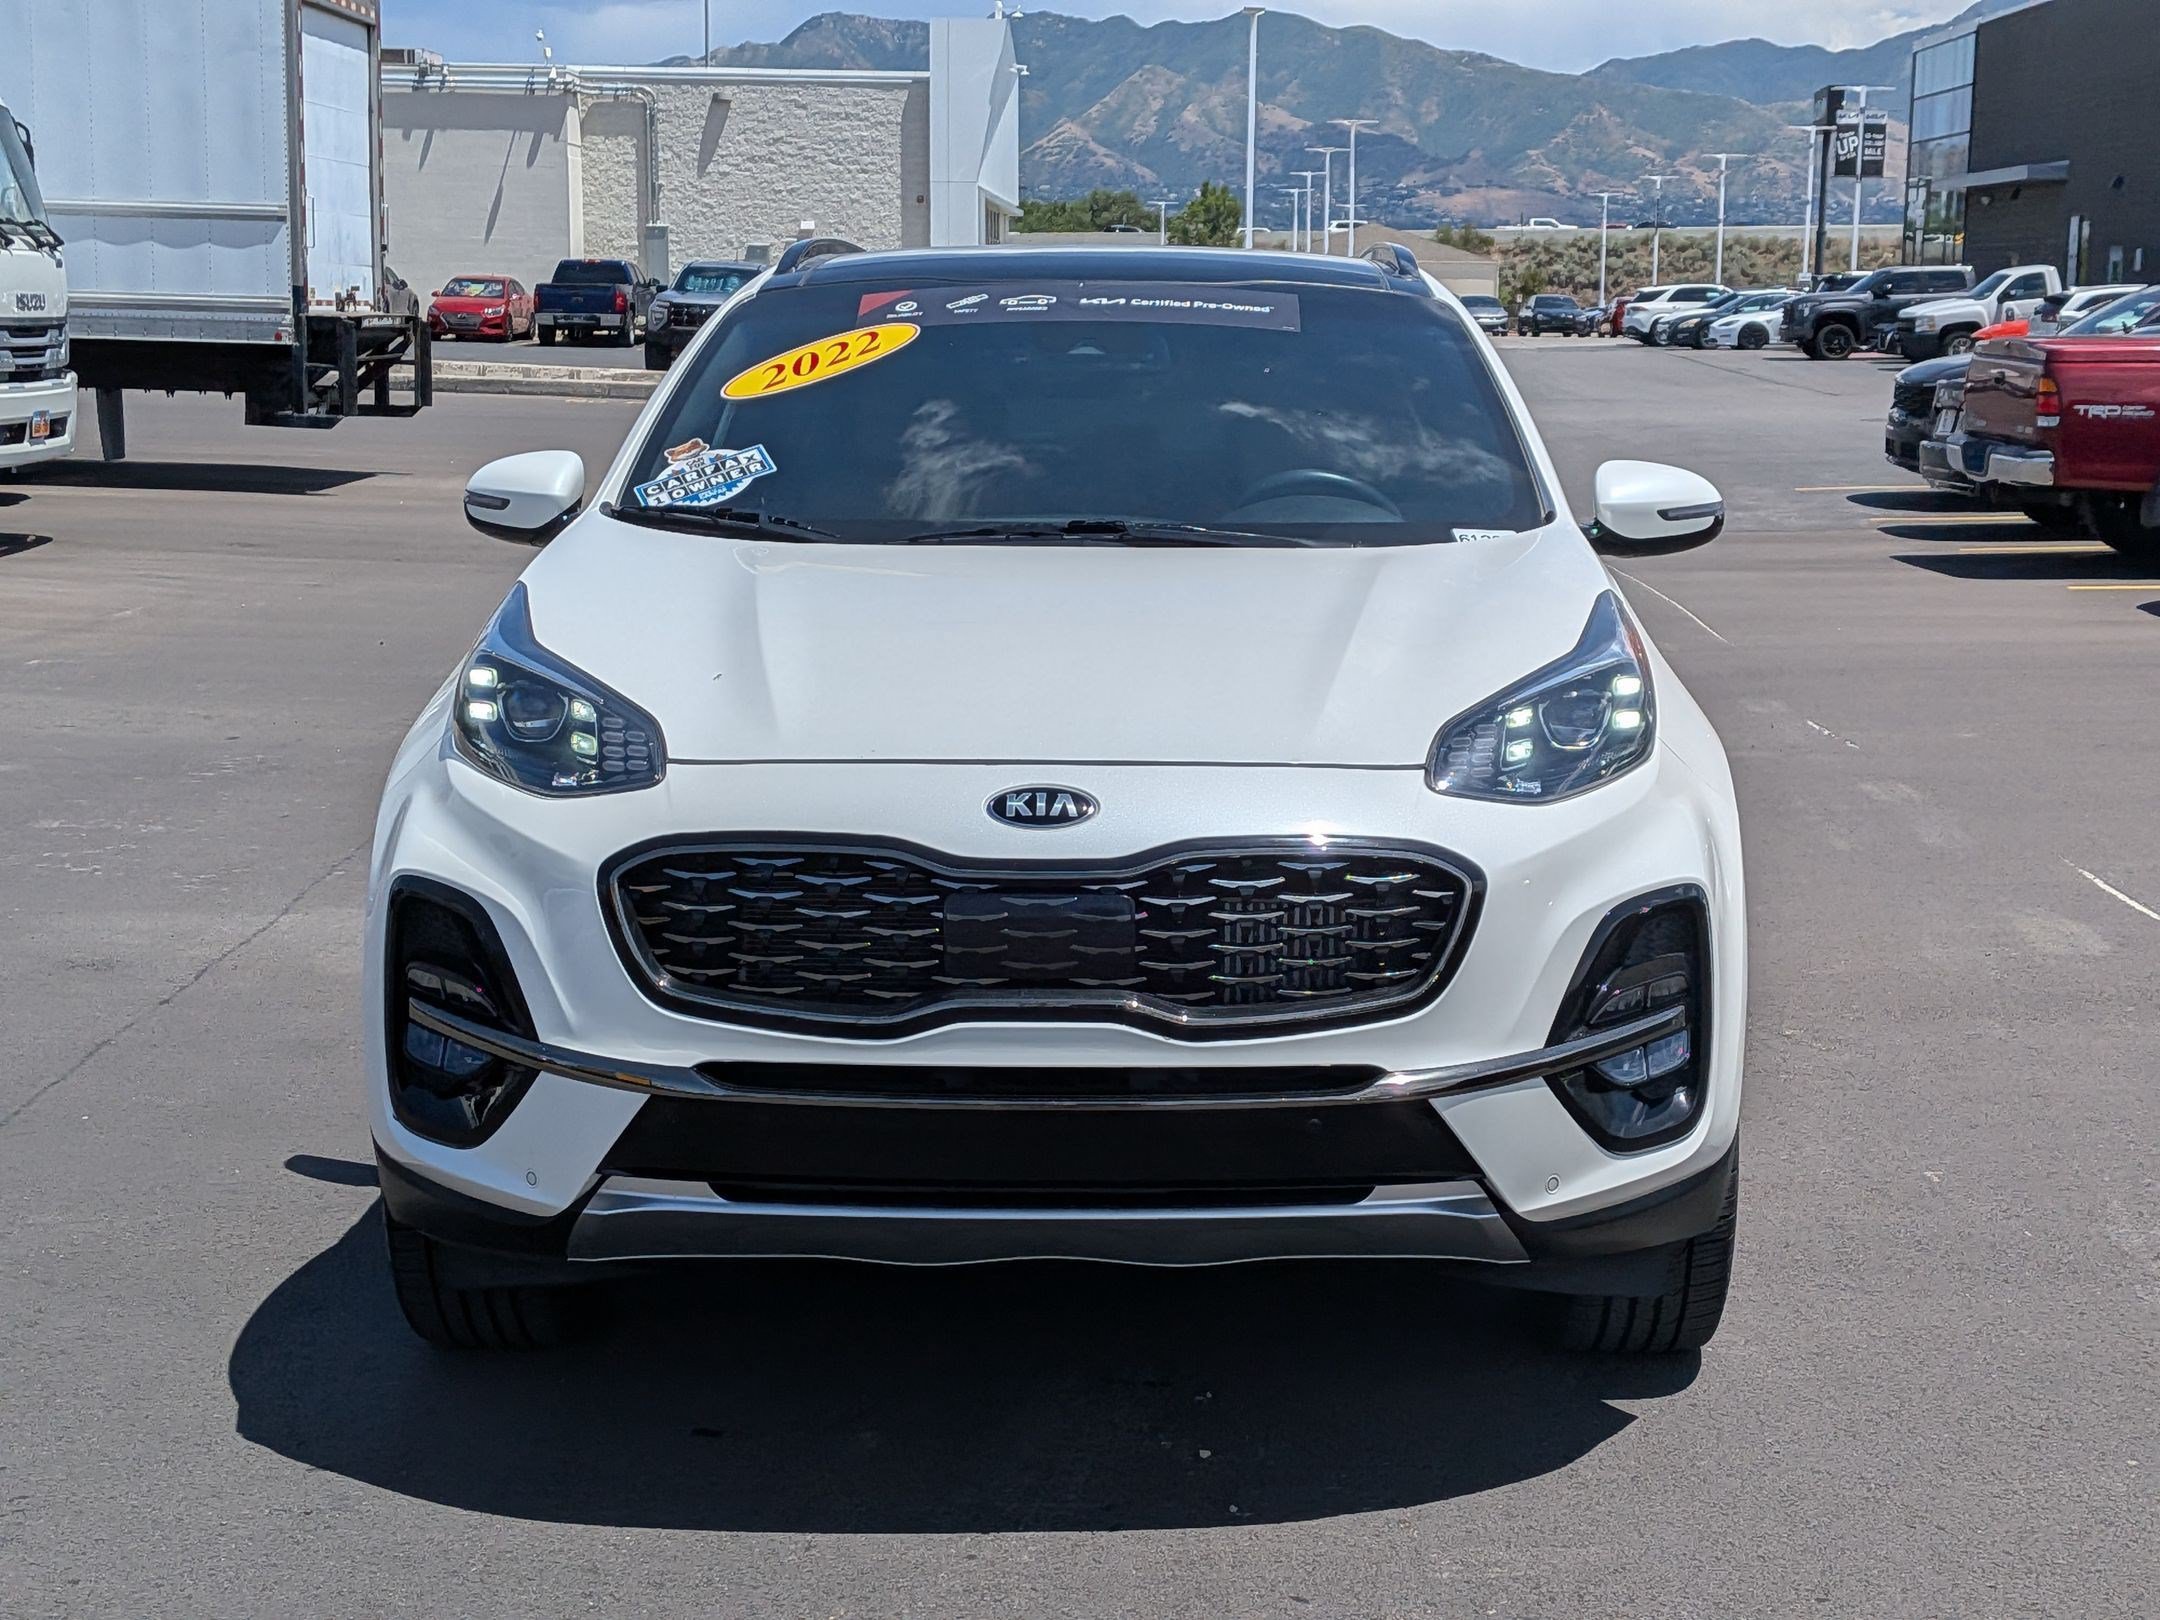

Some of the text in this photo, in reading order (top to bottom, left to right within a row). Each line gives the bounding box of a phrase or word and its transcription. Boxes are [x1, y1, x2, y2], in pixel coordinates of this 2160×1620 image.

[1836, 135, 1859, 155] UP
[16, 293, 46, 311] ISUZU
[1131, 298, 1191, 308] Certified
[761, 331, 882, 391] 2022
[2072, 404, 2121, 420] TRD
[646, 453, 757, 496] CARFAX
[671, 462, 763, 499] OWNER
[1006, 793, 1079, 817] KIA
